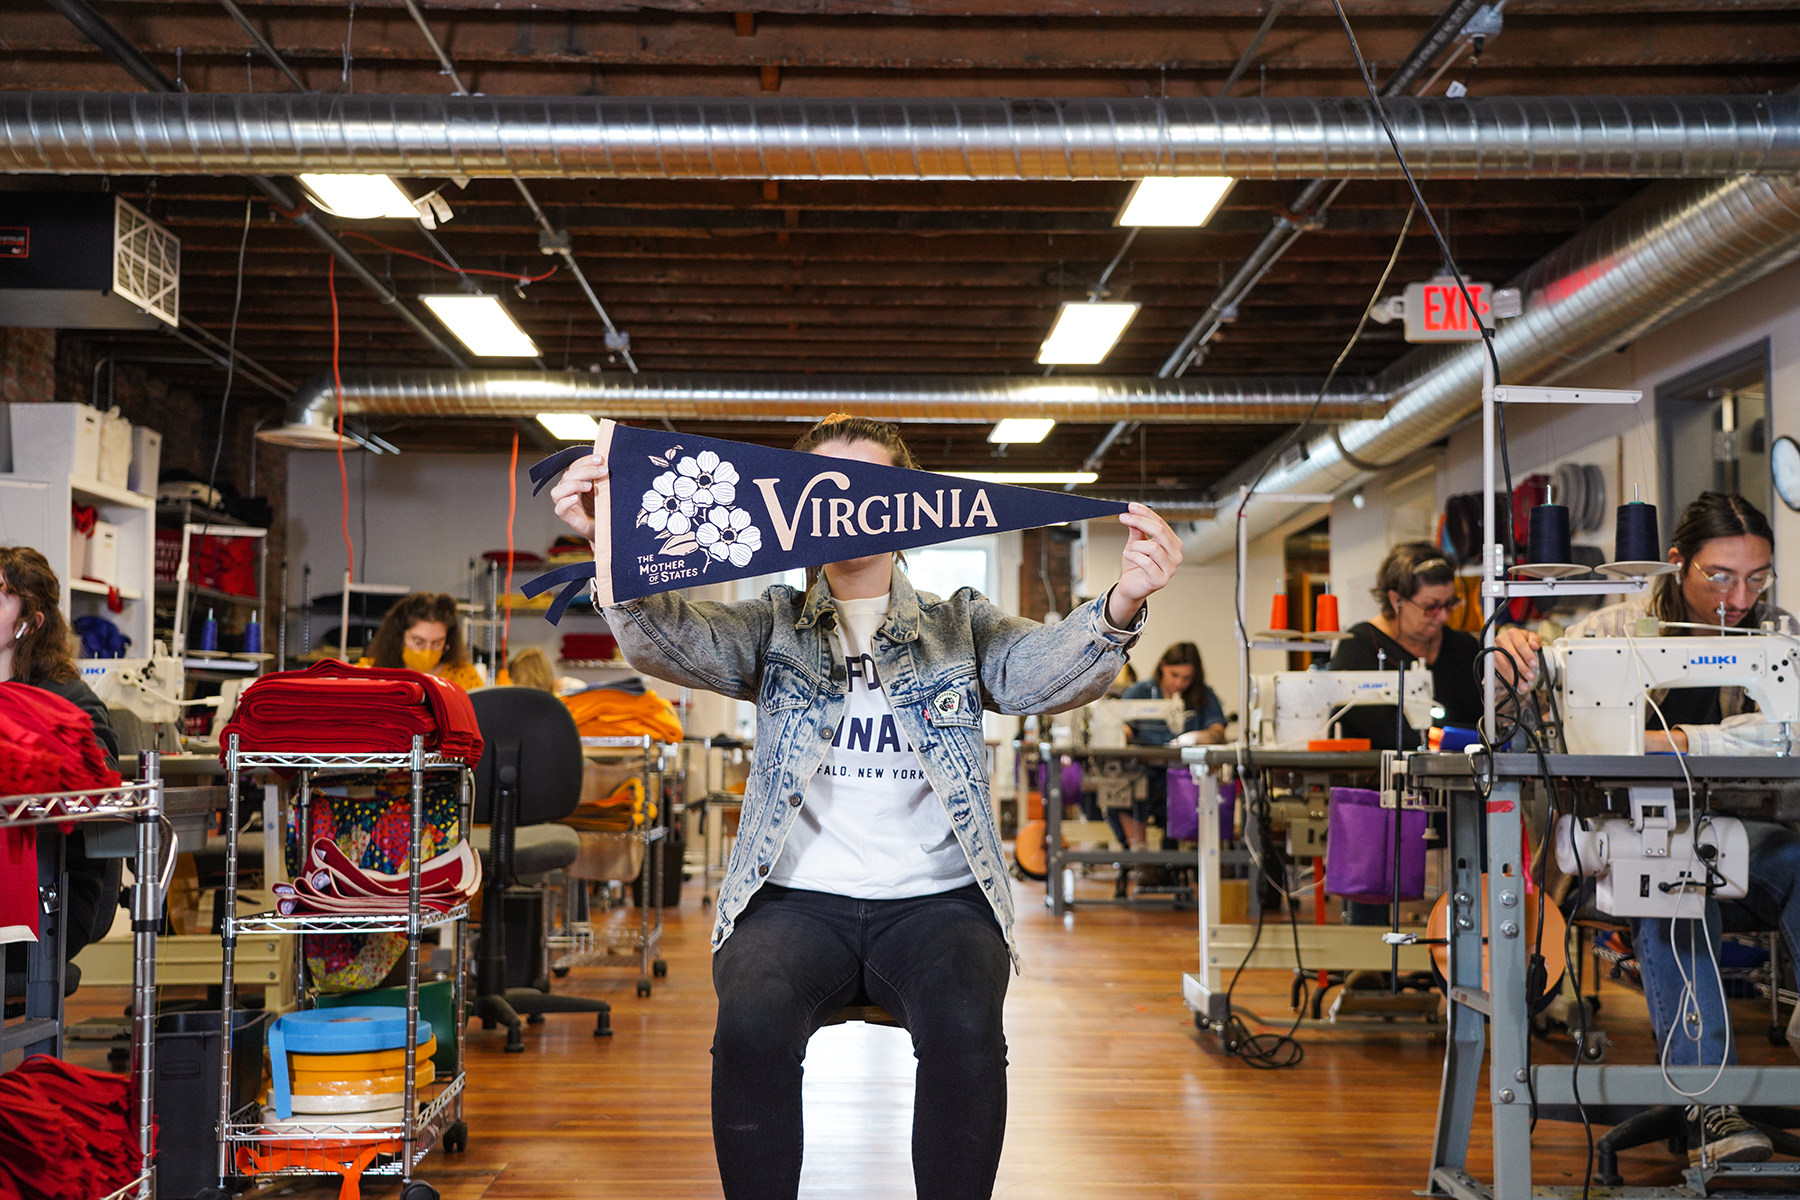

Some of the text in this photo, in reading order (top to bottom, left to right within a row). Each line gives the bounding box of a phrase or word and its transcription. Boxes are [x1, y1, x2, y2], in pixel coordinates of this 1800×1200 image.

[1423, 285, 1484, 331] EXIT
[752, 471, 998, 551] VIRGINIA
[637, 554, 655, 564] THE
[640, 559, 685, 575] MOTHER
[661, 568, 698, 583] STATES
[1691, 656, 1737, 664] JUKI
[858, 768, 884, 779] NEW
[893, 769, 925, 780] YORK
